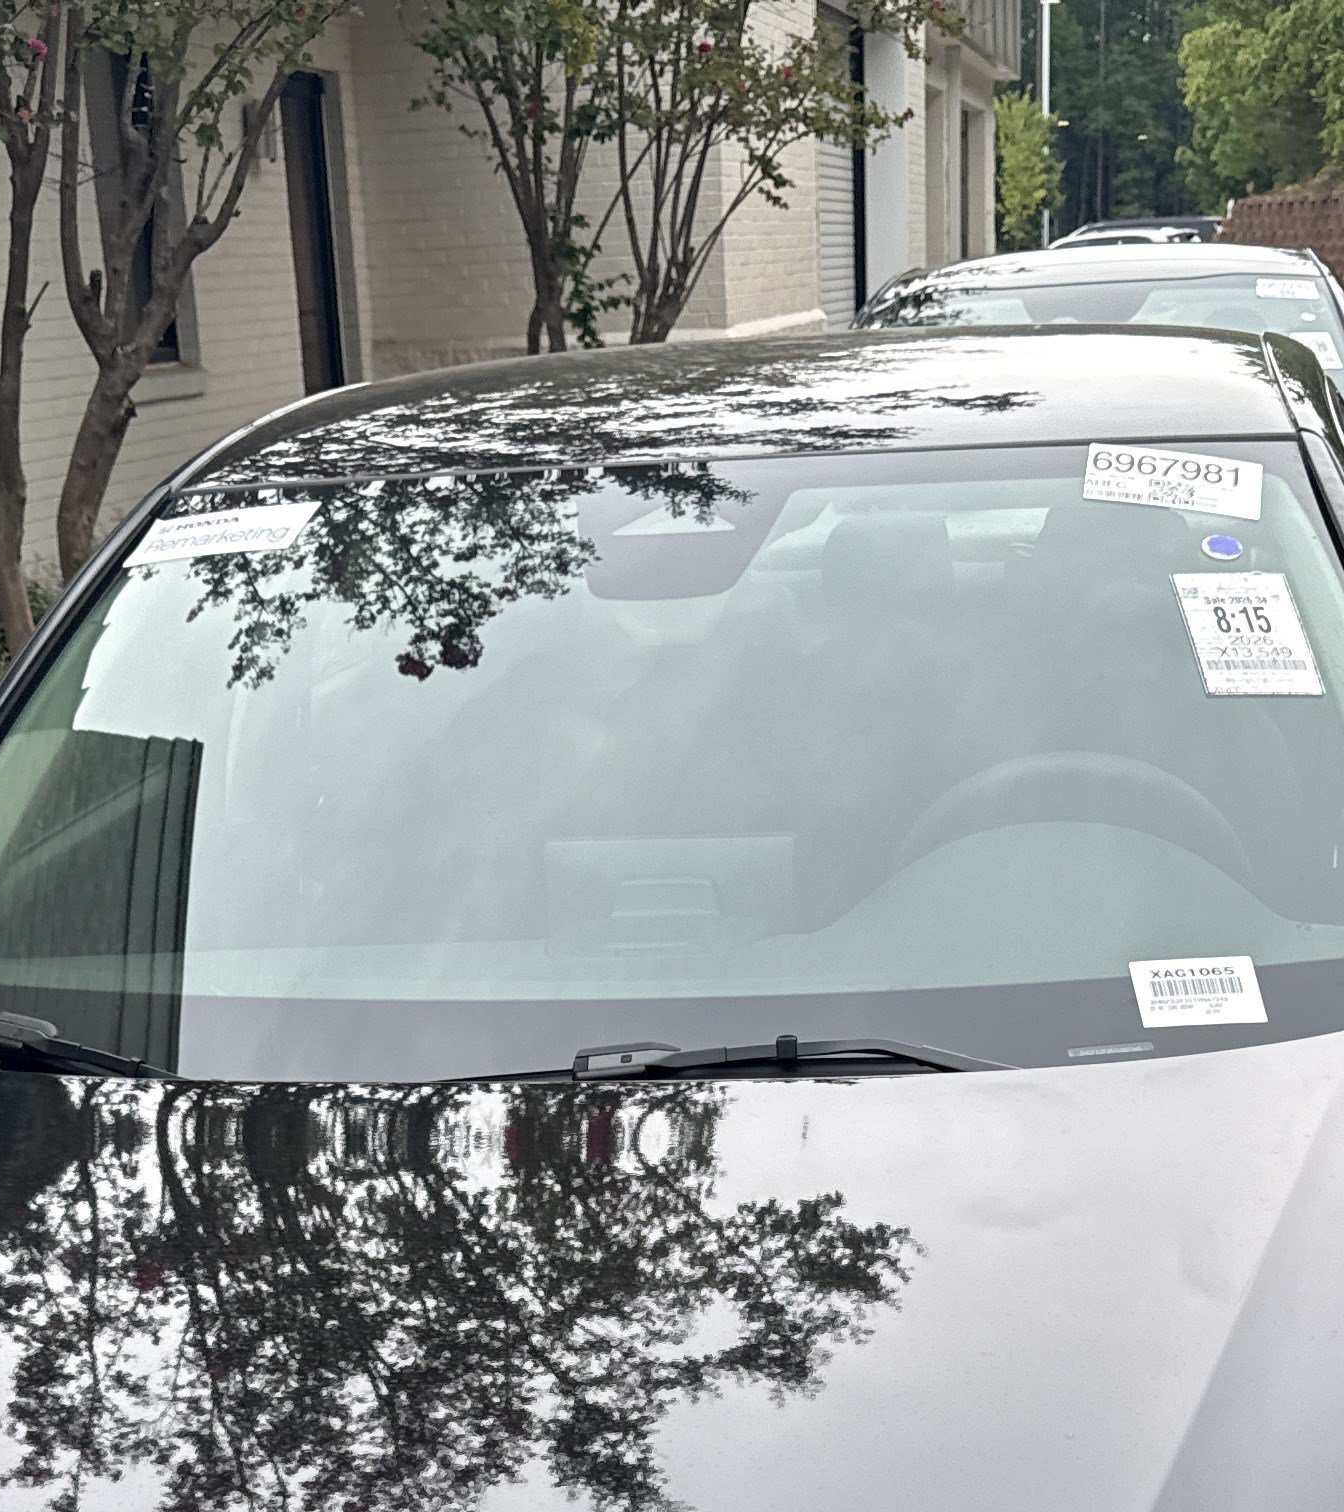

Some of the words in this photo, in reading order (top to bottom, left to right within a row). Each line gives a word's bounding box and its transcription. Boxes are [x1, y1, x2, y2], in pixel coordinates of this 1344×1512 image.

[1092, 450, 1241, 487] 6967981
[143, 525, 292, 553] Remarketing
[1213, 606, 1272, 634] 8:15
[1228, 635, 1274, 646] 2026
[1150, 967, 1235, 979] XAG1065
